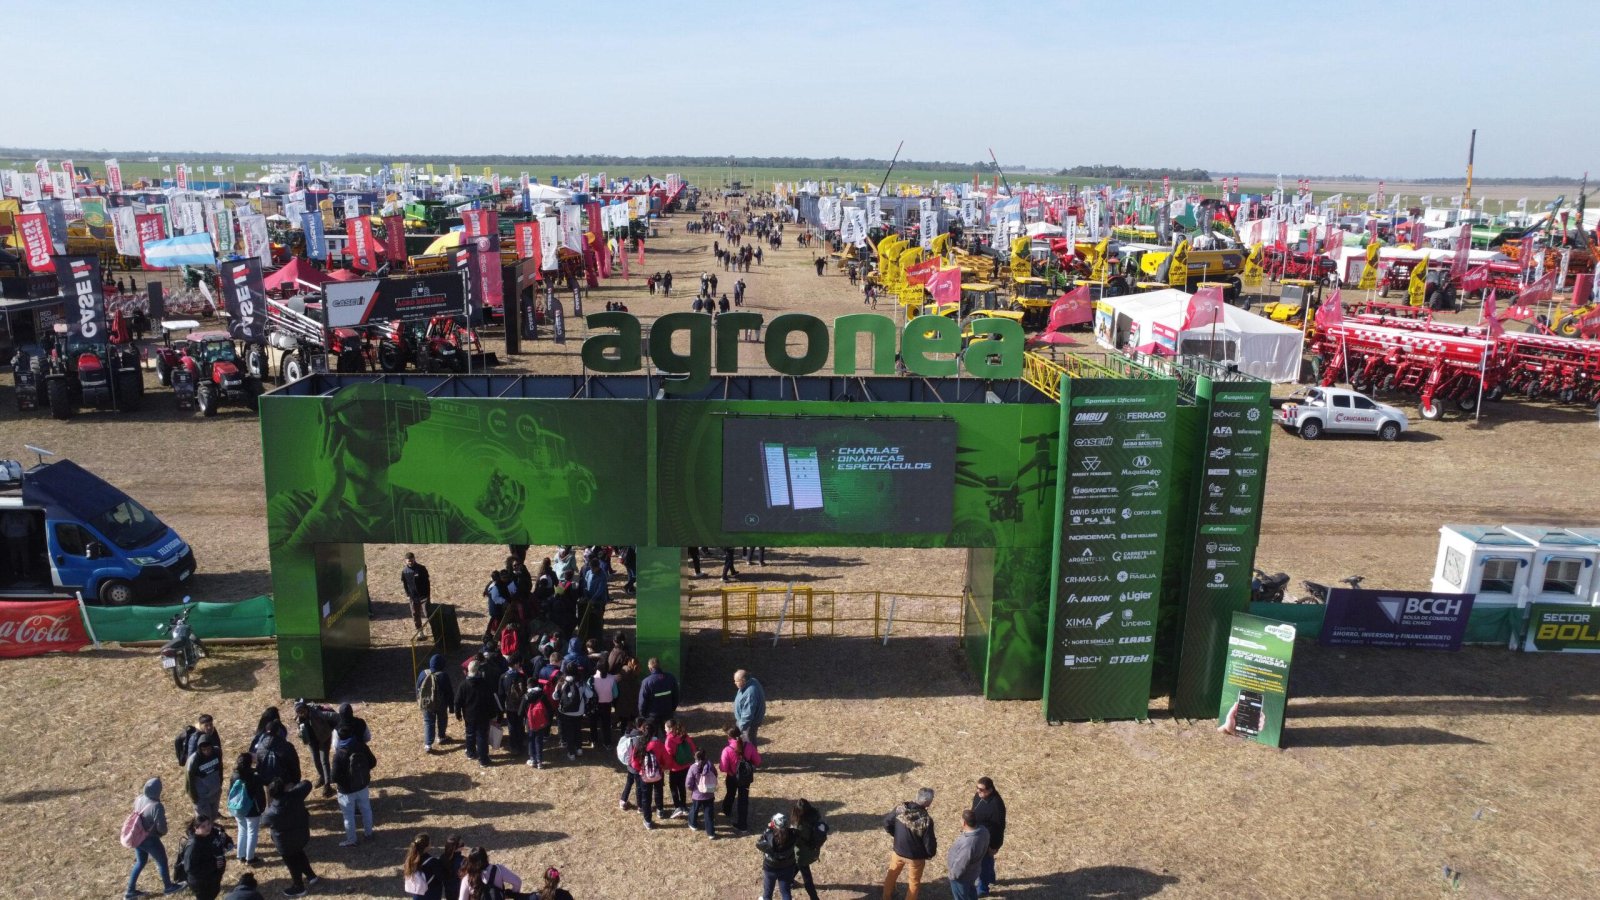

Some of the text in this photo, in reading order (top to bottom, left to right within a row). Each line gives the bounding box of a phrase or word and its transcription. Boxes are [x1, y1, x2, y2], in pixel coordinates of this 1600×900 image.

[581, 311, 1025, 395] agronea
[1075, 412, 1103, 421] OMBU
[1343, 415, 1375, 423] CRUCIANELLI
[1213, 426, 1233, 434] AFA
[838, 447, 899, 455] CHARLAS
[837, 454, 904, 462] DINÁMICAS
[837, 461, 932, 470] ESPECTÁCULOS
[1127, 591, 1152, 601] Ligier
[1405, 597, 1463, 615] BCCH
[1065, 618, 1093, 626] XIMA
[1543, 613, 1591, 622] SECTOR
[1537, 624, 1600, 640] BOL
[1118, 635, 1152, 644] CLAAS
